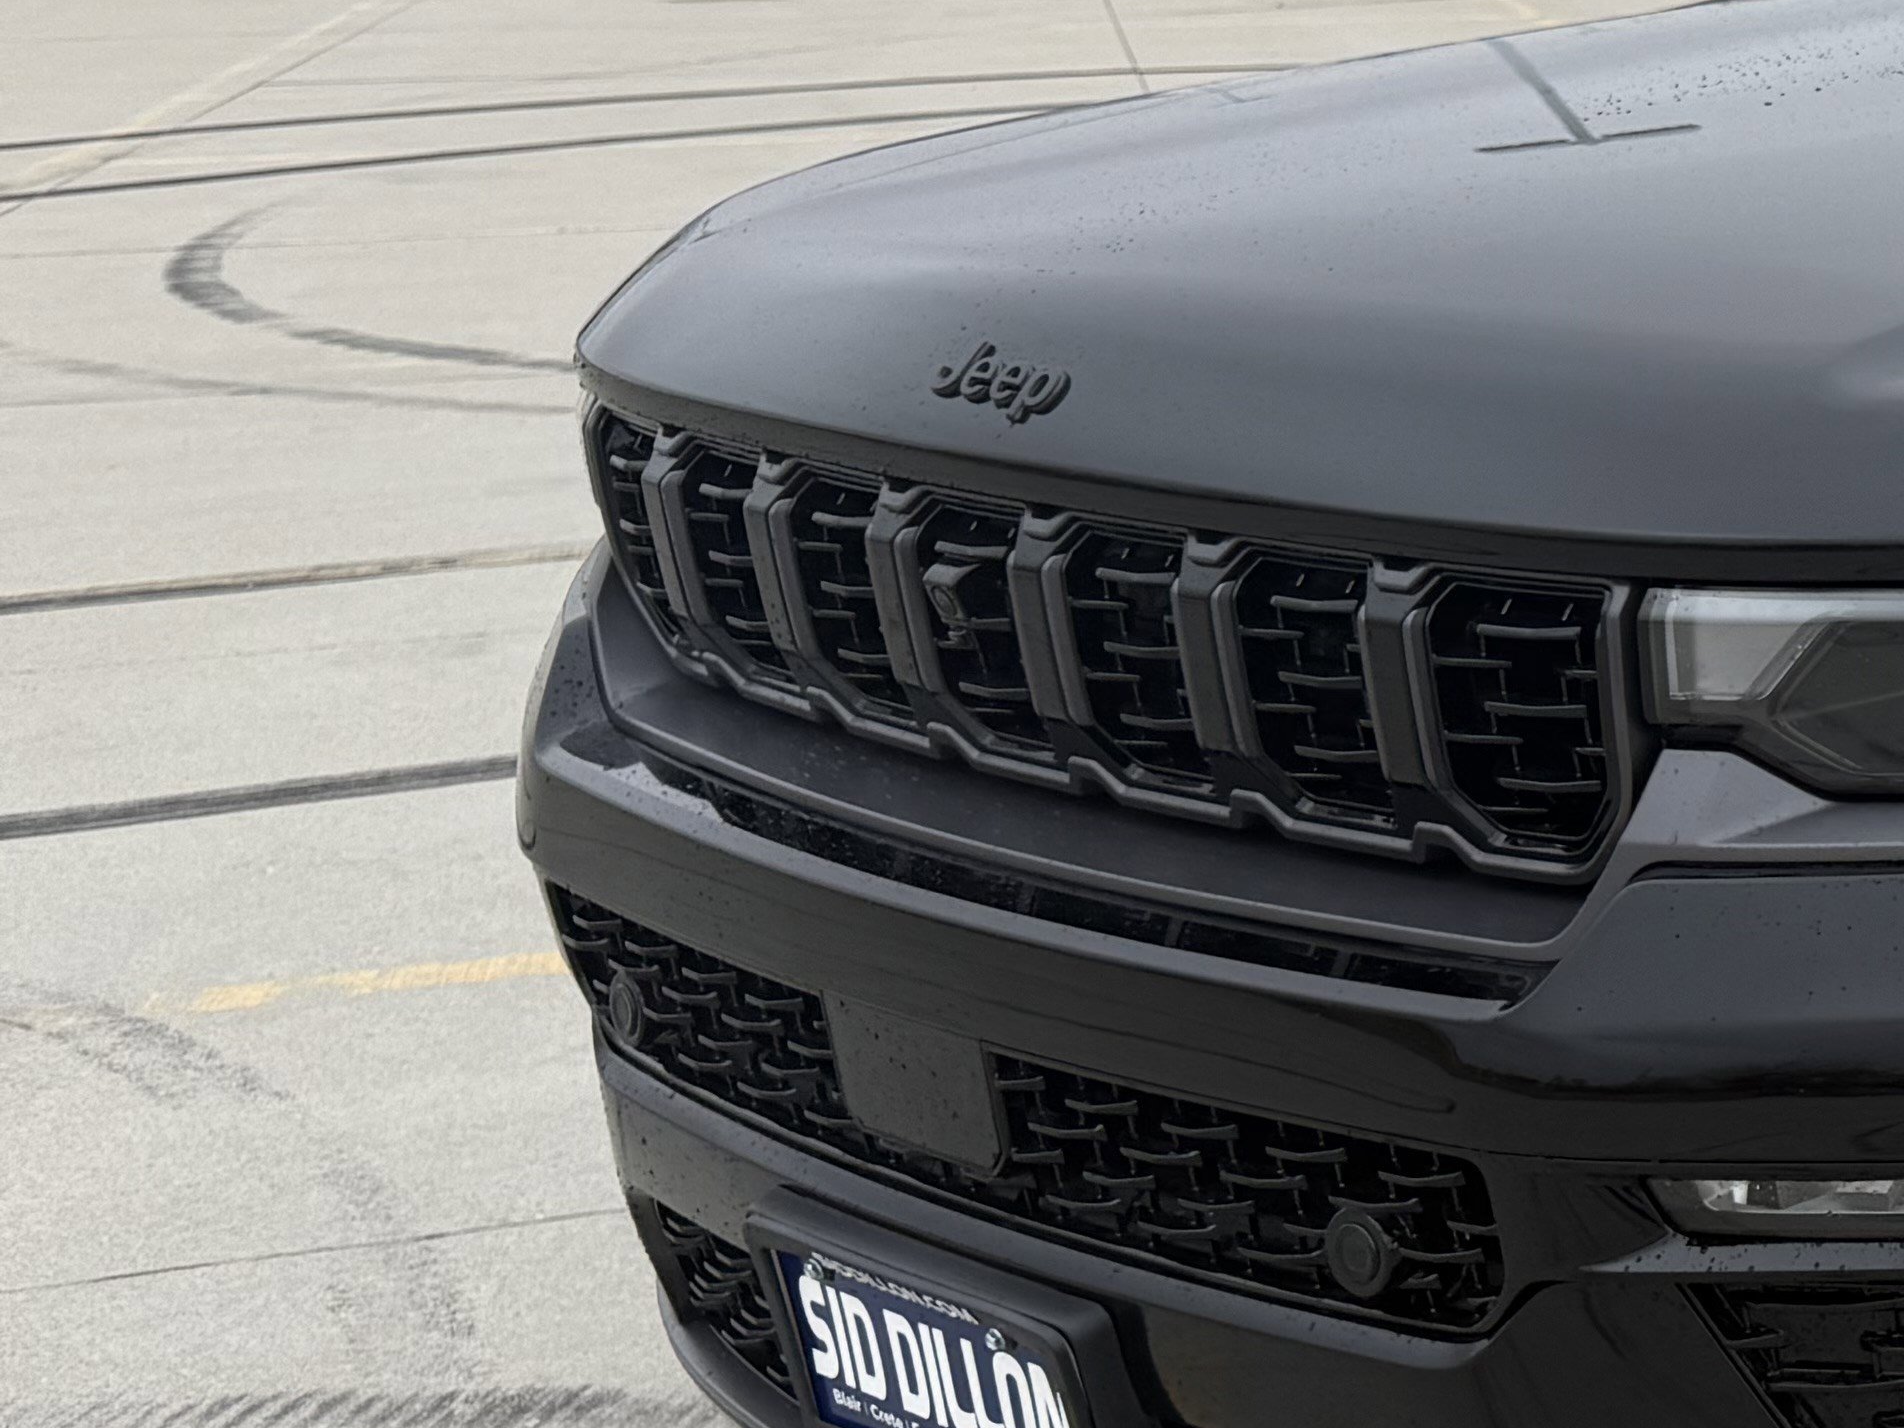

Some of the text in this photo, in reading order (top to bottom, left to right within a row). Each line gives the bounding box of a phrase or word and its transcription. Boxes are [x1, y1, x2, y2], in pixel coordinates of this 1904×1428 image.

[931, 341, 1071, 426] Jeep
[798, 1273, 887, 1401] SID
[832, 1388, 862, 1414] Blair
